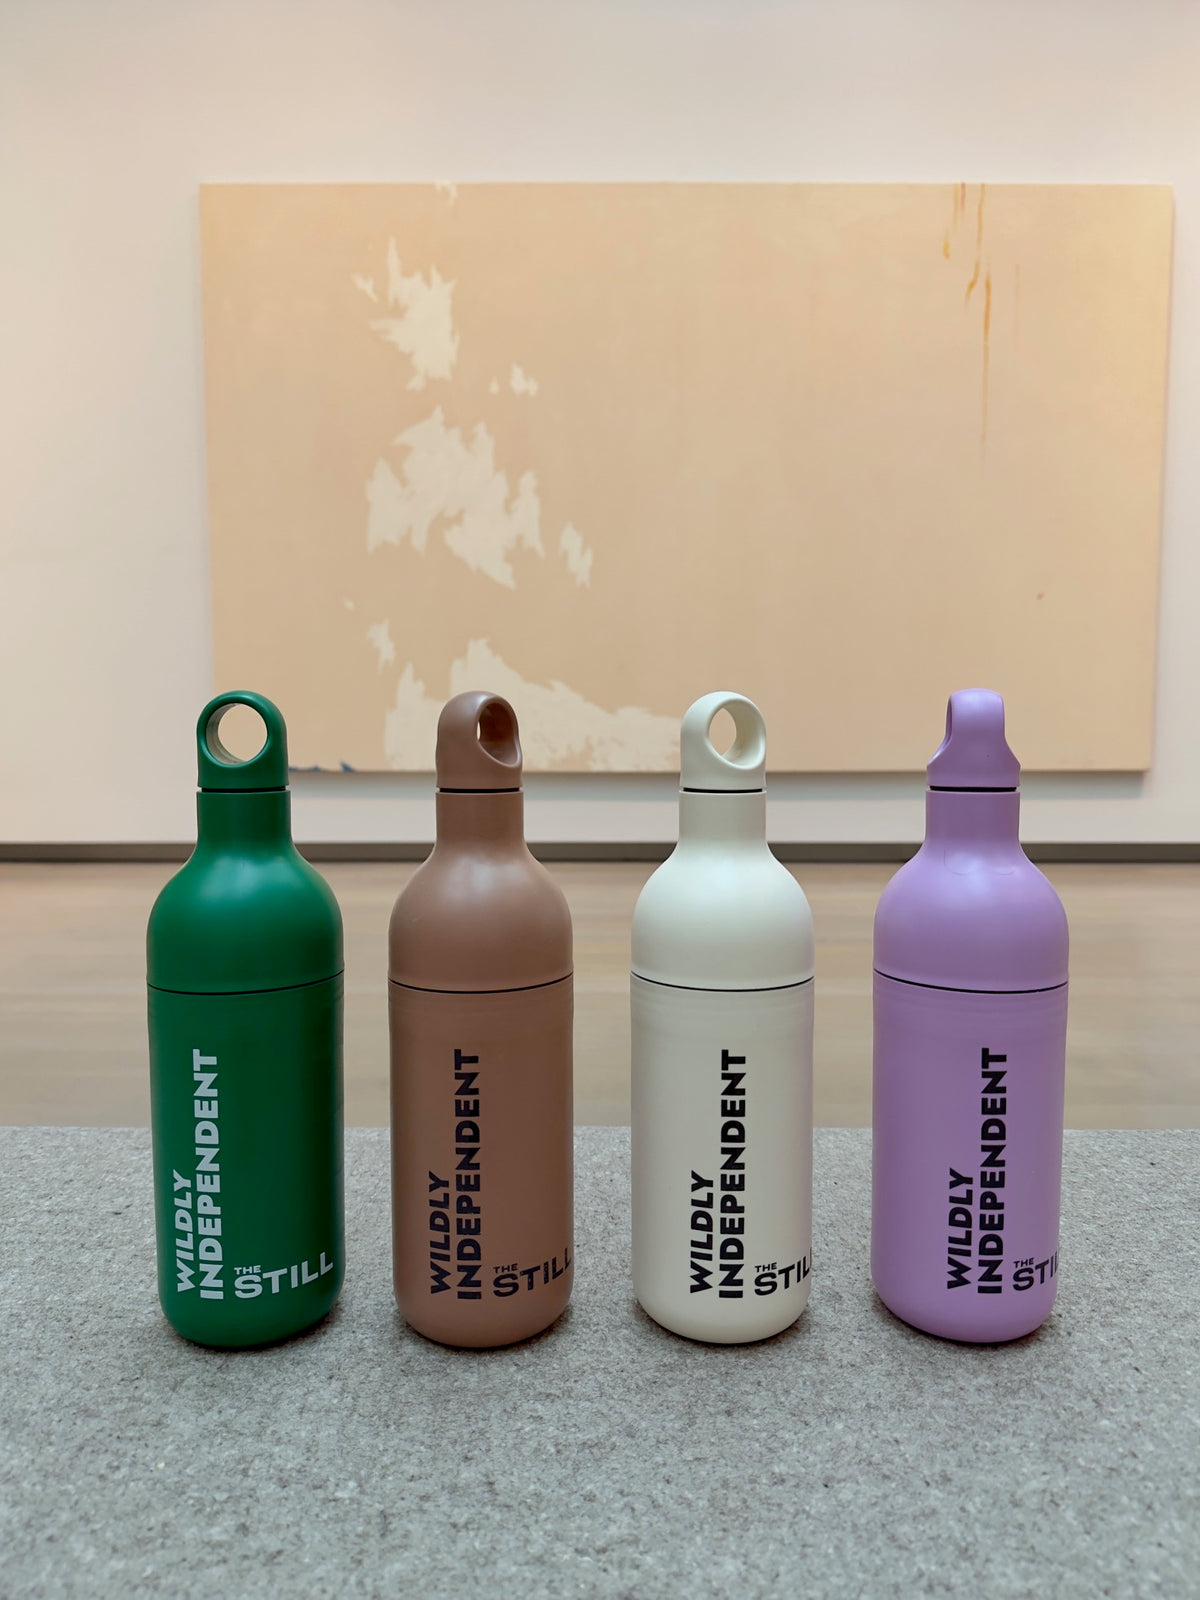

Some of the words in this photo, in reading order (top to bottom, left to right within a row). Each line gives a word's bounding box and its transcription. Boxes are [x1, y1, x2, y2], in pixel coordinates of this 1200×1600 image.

[172, 1168, 196, 1292] WILDLY
[192, 1048, 224, 1300] INDEPENDENT
[428, 1170, 451, 1294] WILDLY
[453, 1048, 482, 1300] INDEPENDENT
[689, 1169, 714, 1294] WILDLY
[718, 1049, 747, 1299] INDEPENDENT
[946, 1167, 973, 1290] WILDLY
[977, 1047, 1008, 1294] INDEPENDENT
[234, 1265, 262, 1275] THE
[234, 1251, 334, 1299] STILL
[492, 1247, 571, 1298] STILL
[493, 1263, 518, 1274] THE
[754, 1262, 777, 1273] THE
[1013, 1257, 1034, 1268] THE
